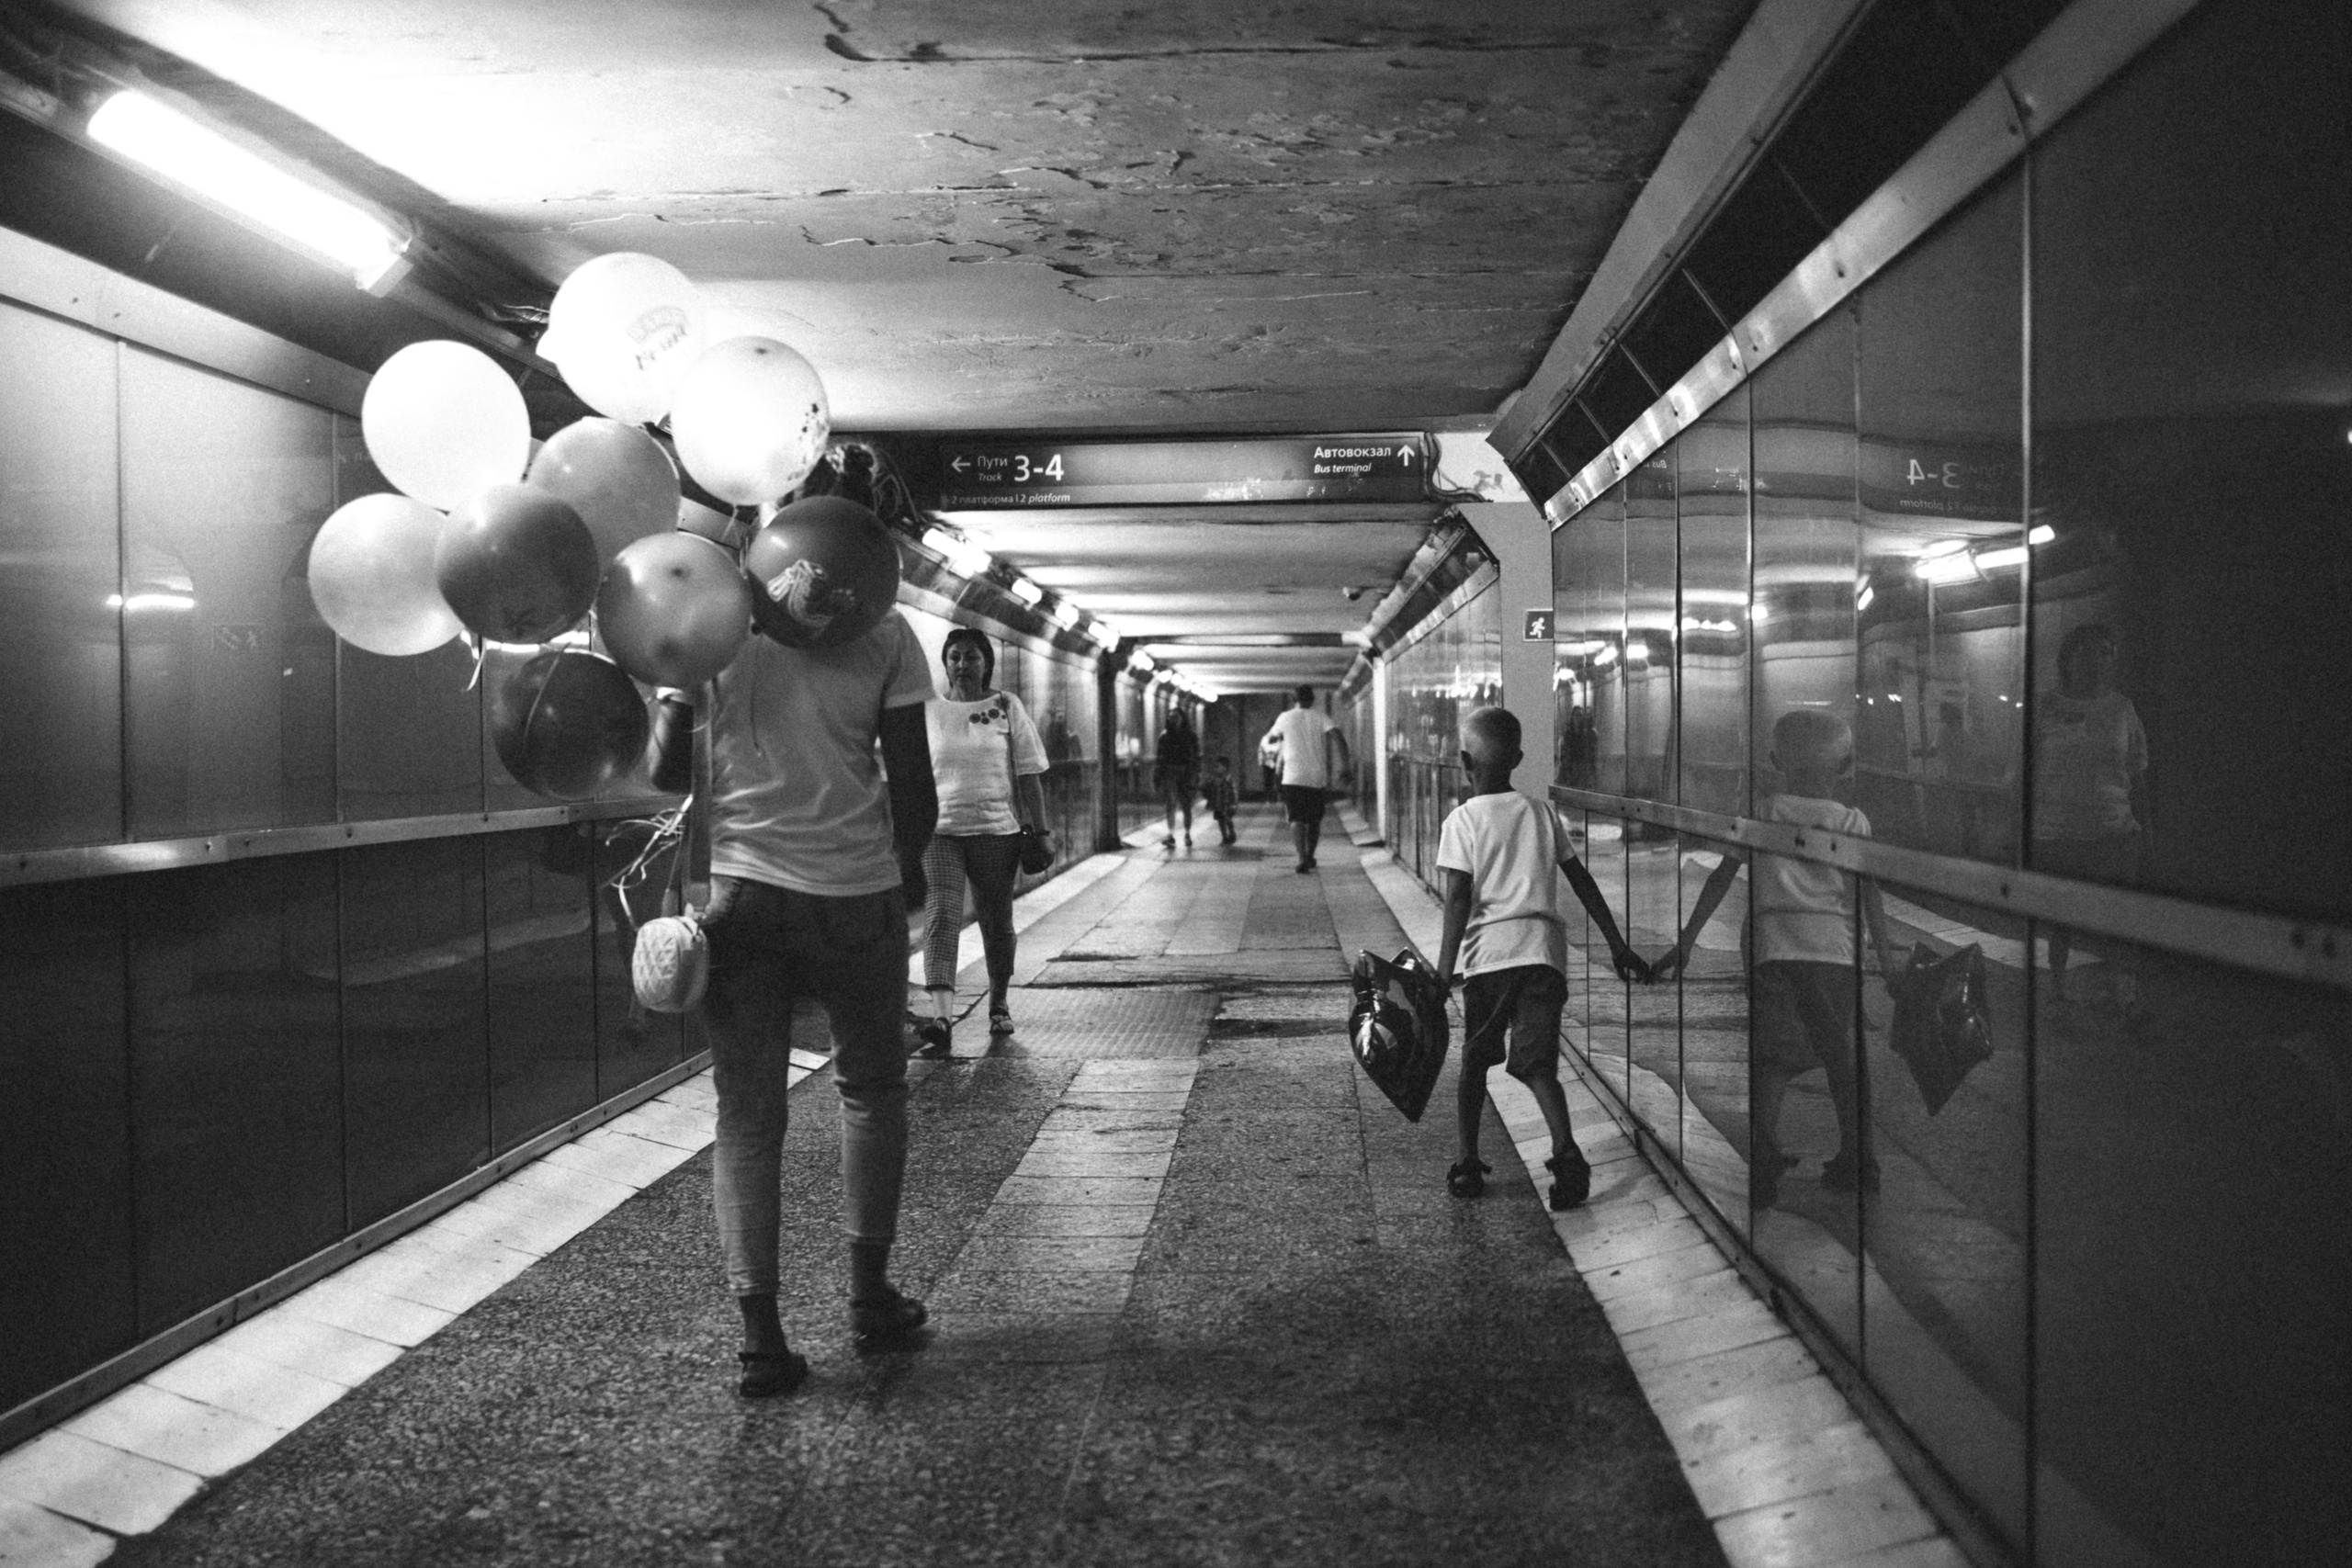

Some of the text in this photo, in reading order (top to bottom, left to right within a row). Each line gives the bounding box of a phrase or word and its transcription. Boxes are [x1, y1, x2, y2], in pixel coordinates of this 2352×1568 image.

[1314, 446, 1391, 458] Автовокзал
[978, 454, 1064, 481] Пути 3-4
[1314, 463, 1372, 473] Bus terminal
[978, 472, 1002, 482] Track
[960, 495, 1013, 505] платформа
[1028, 492, 1070, 504] platform
